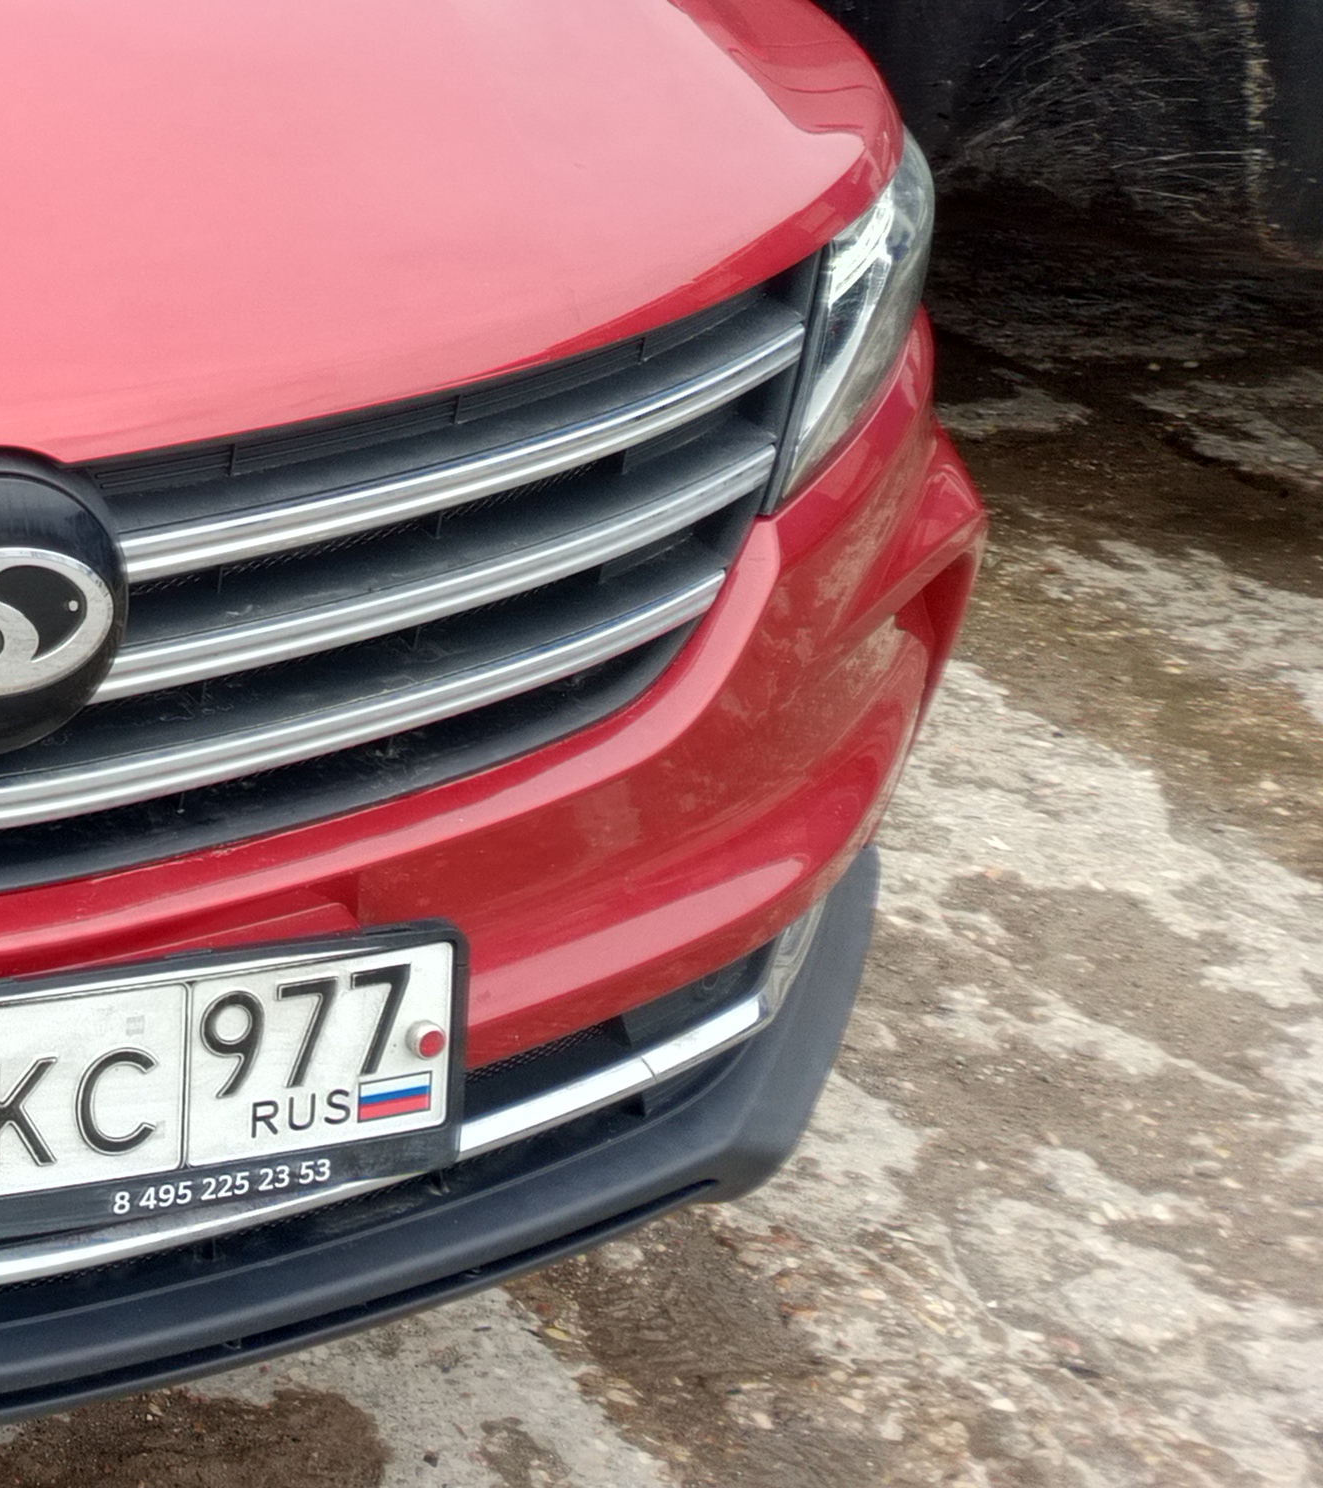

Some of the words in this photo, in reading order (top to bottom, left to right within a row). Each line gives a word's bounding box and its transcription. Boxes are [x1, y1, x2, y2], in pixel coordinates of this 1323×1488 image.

[199, 963, 413, 1100] 977
[250, 1088, 352, 1139] RUS
[112, 1189, 131, 1215] 8
[139, 1179, 194, 1211] 495
[200, 1170, 251, 1202] 225
[257, 1164, 292, 1195] 23
[297, 1158, 332, 1188] 53
